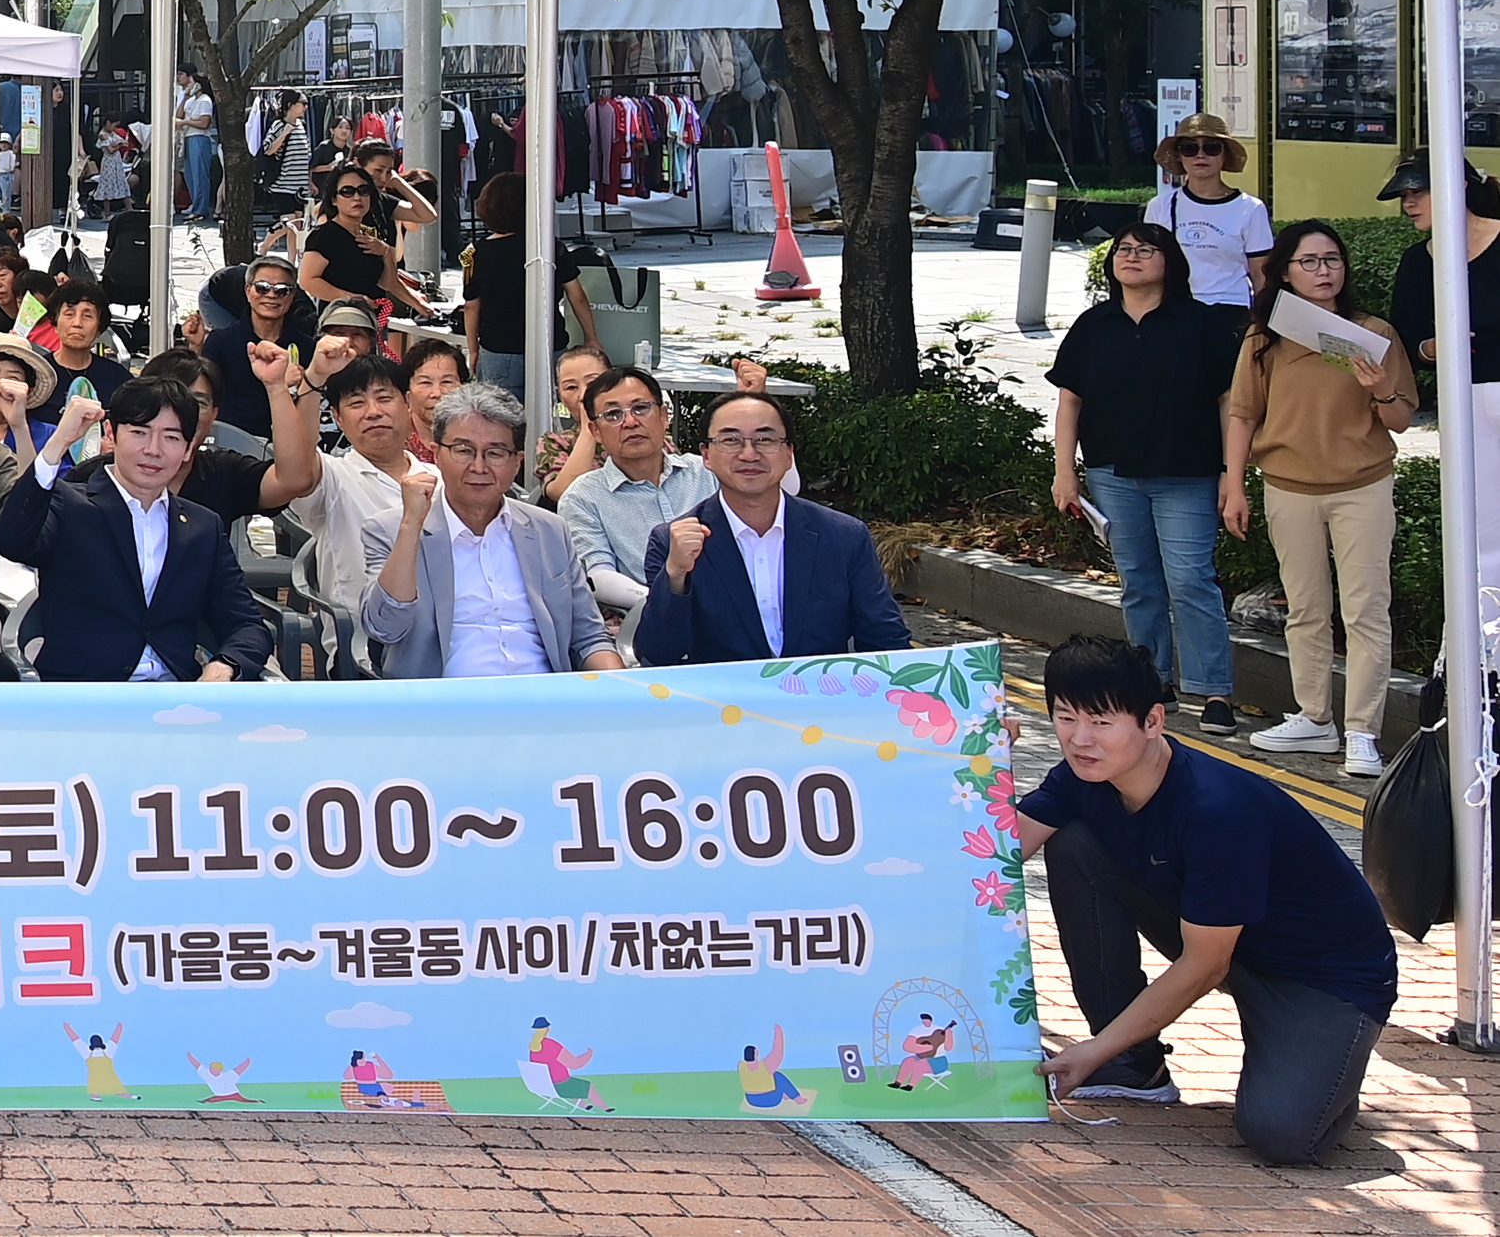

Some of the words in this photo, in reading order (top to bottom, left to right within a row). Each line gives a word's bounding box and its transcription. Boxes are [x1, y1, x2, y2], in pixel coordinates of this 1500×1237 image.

[1328, 15, 1349, 28] Jeep
[134, 784, 519, 874] 11:00~
[559, 772, 857, 865] 16:00
[113, 927, 466, 987] (가을동~겨울동
[608, 911, 868, 972] 차없는거리)
